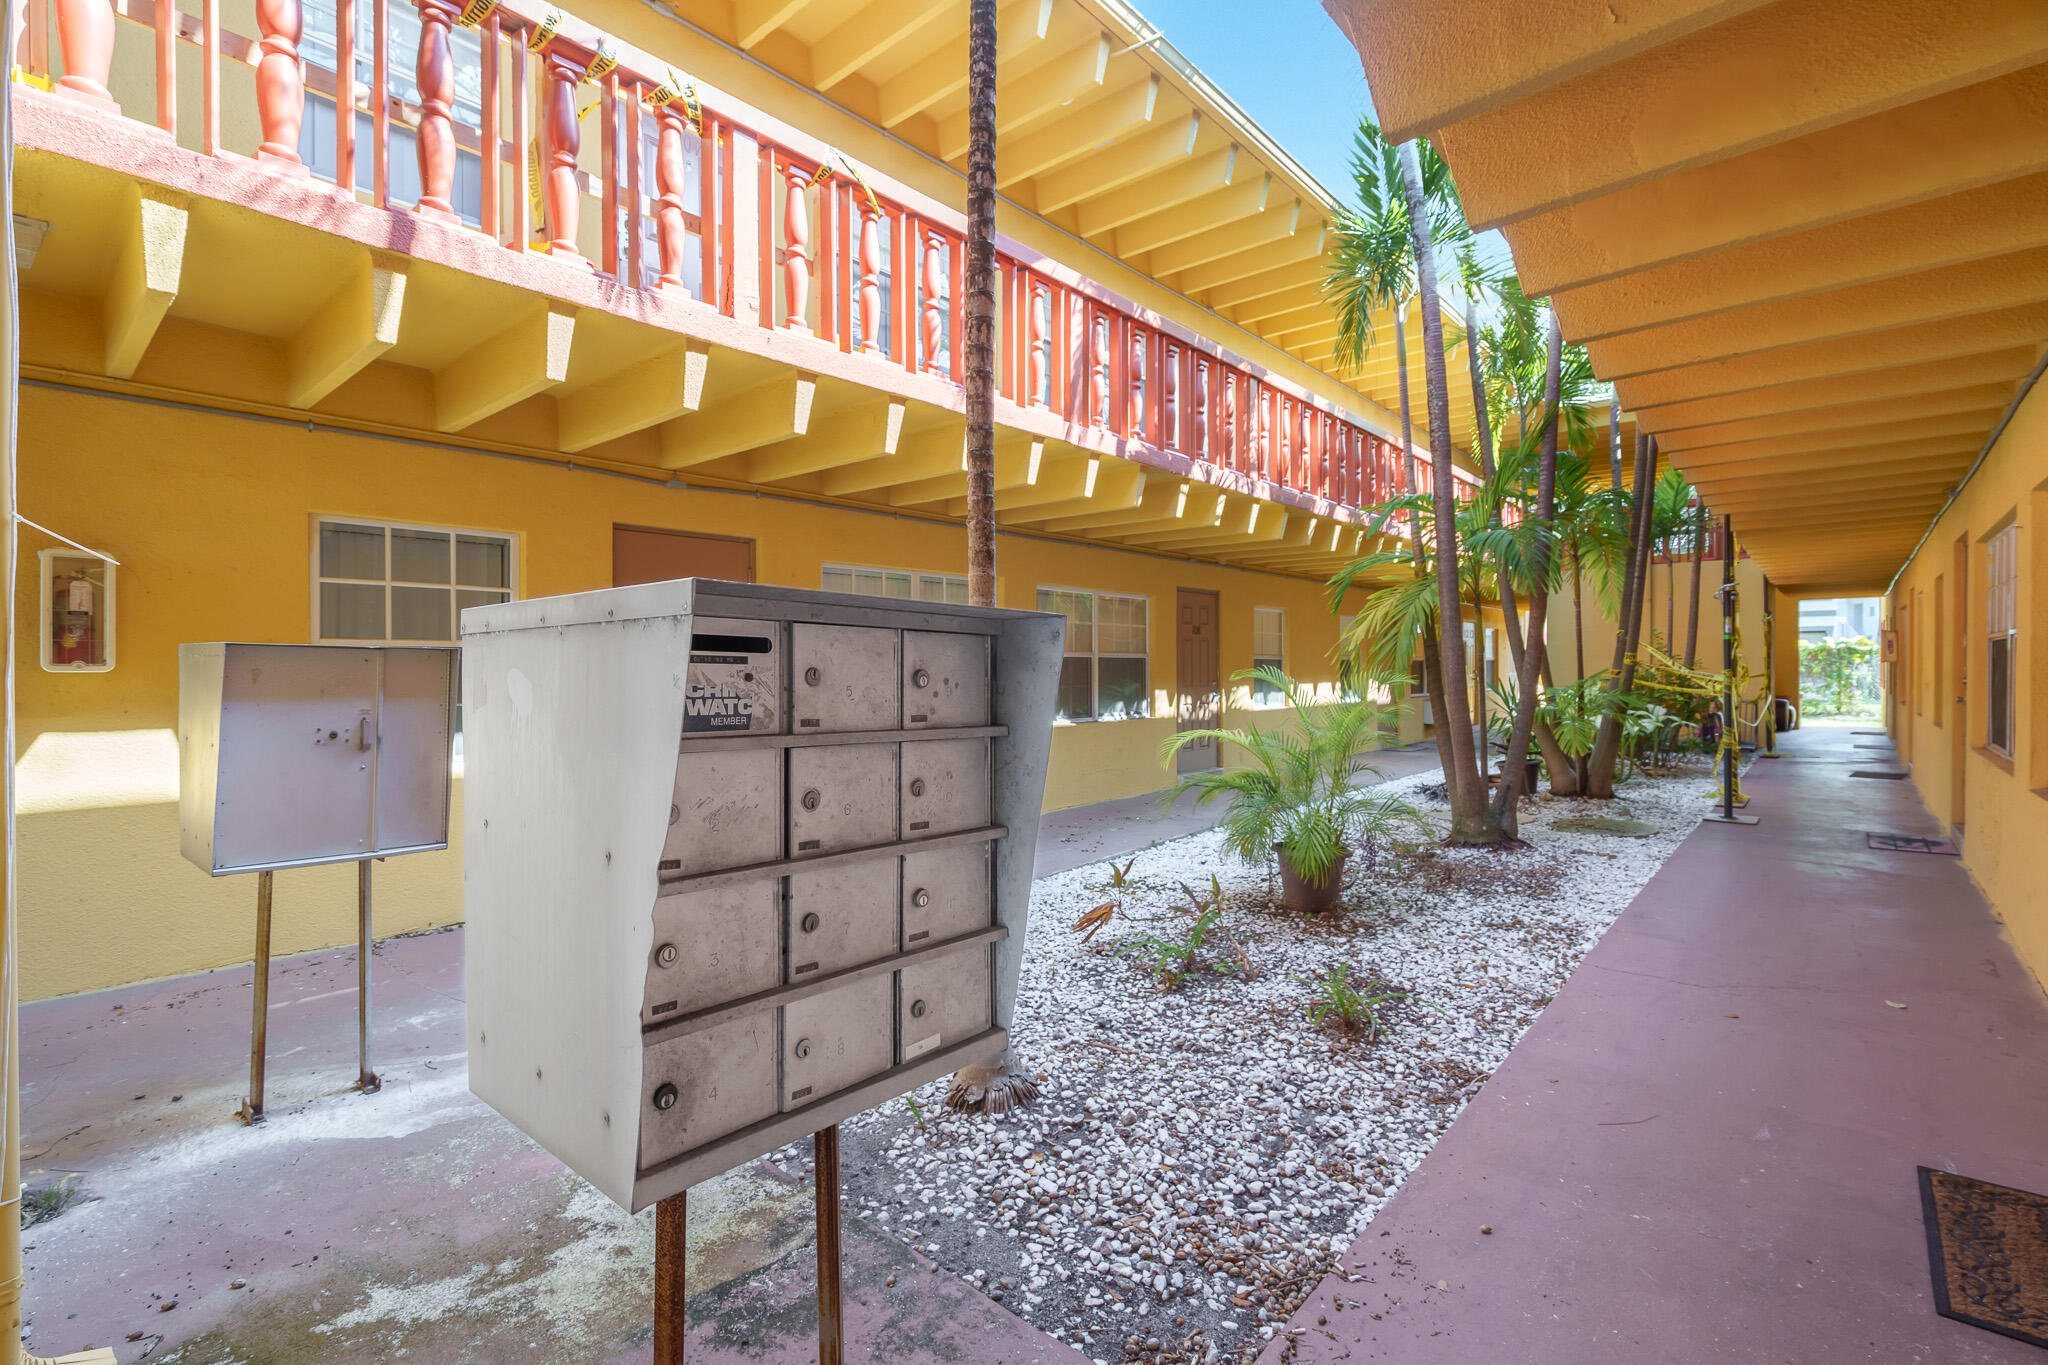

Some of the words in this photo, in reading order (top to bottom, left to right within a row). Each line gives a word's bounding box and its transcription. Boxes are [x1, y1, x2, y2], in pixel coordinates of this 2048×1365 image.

[461, 0, 493, 28] AUTION
[686, 698, 752, 716] WATC
[710, 716, 747, 726] MEMBER
